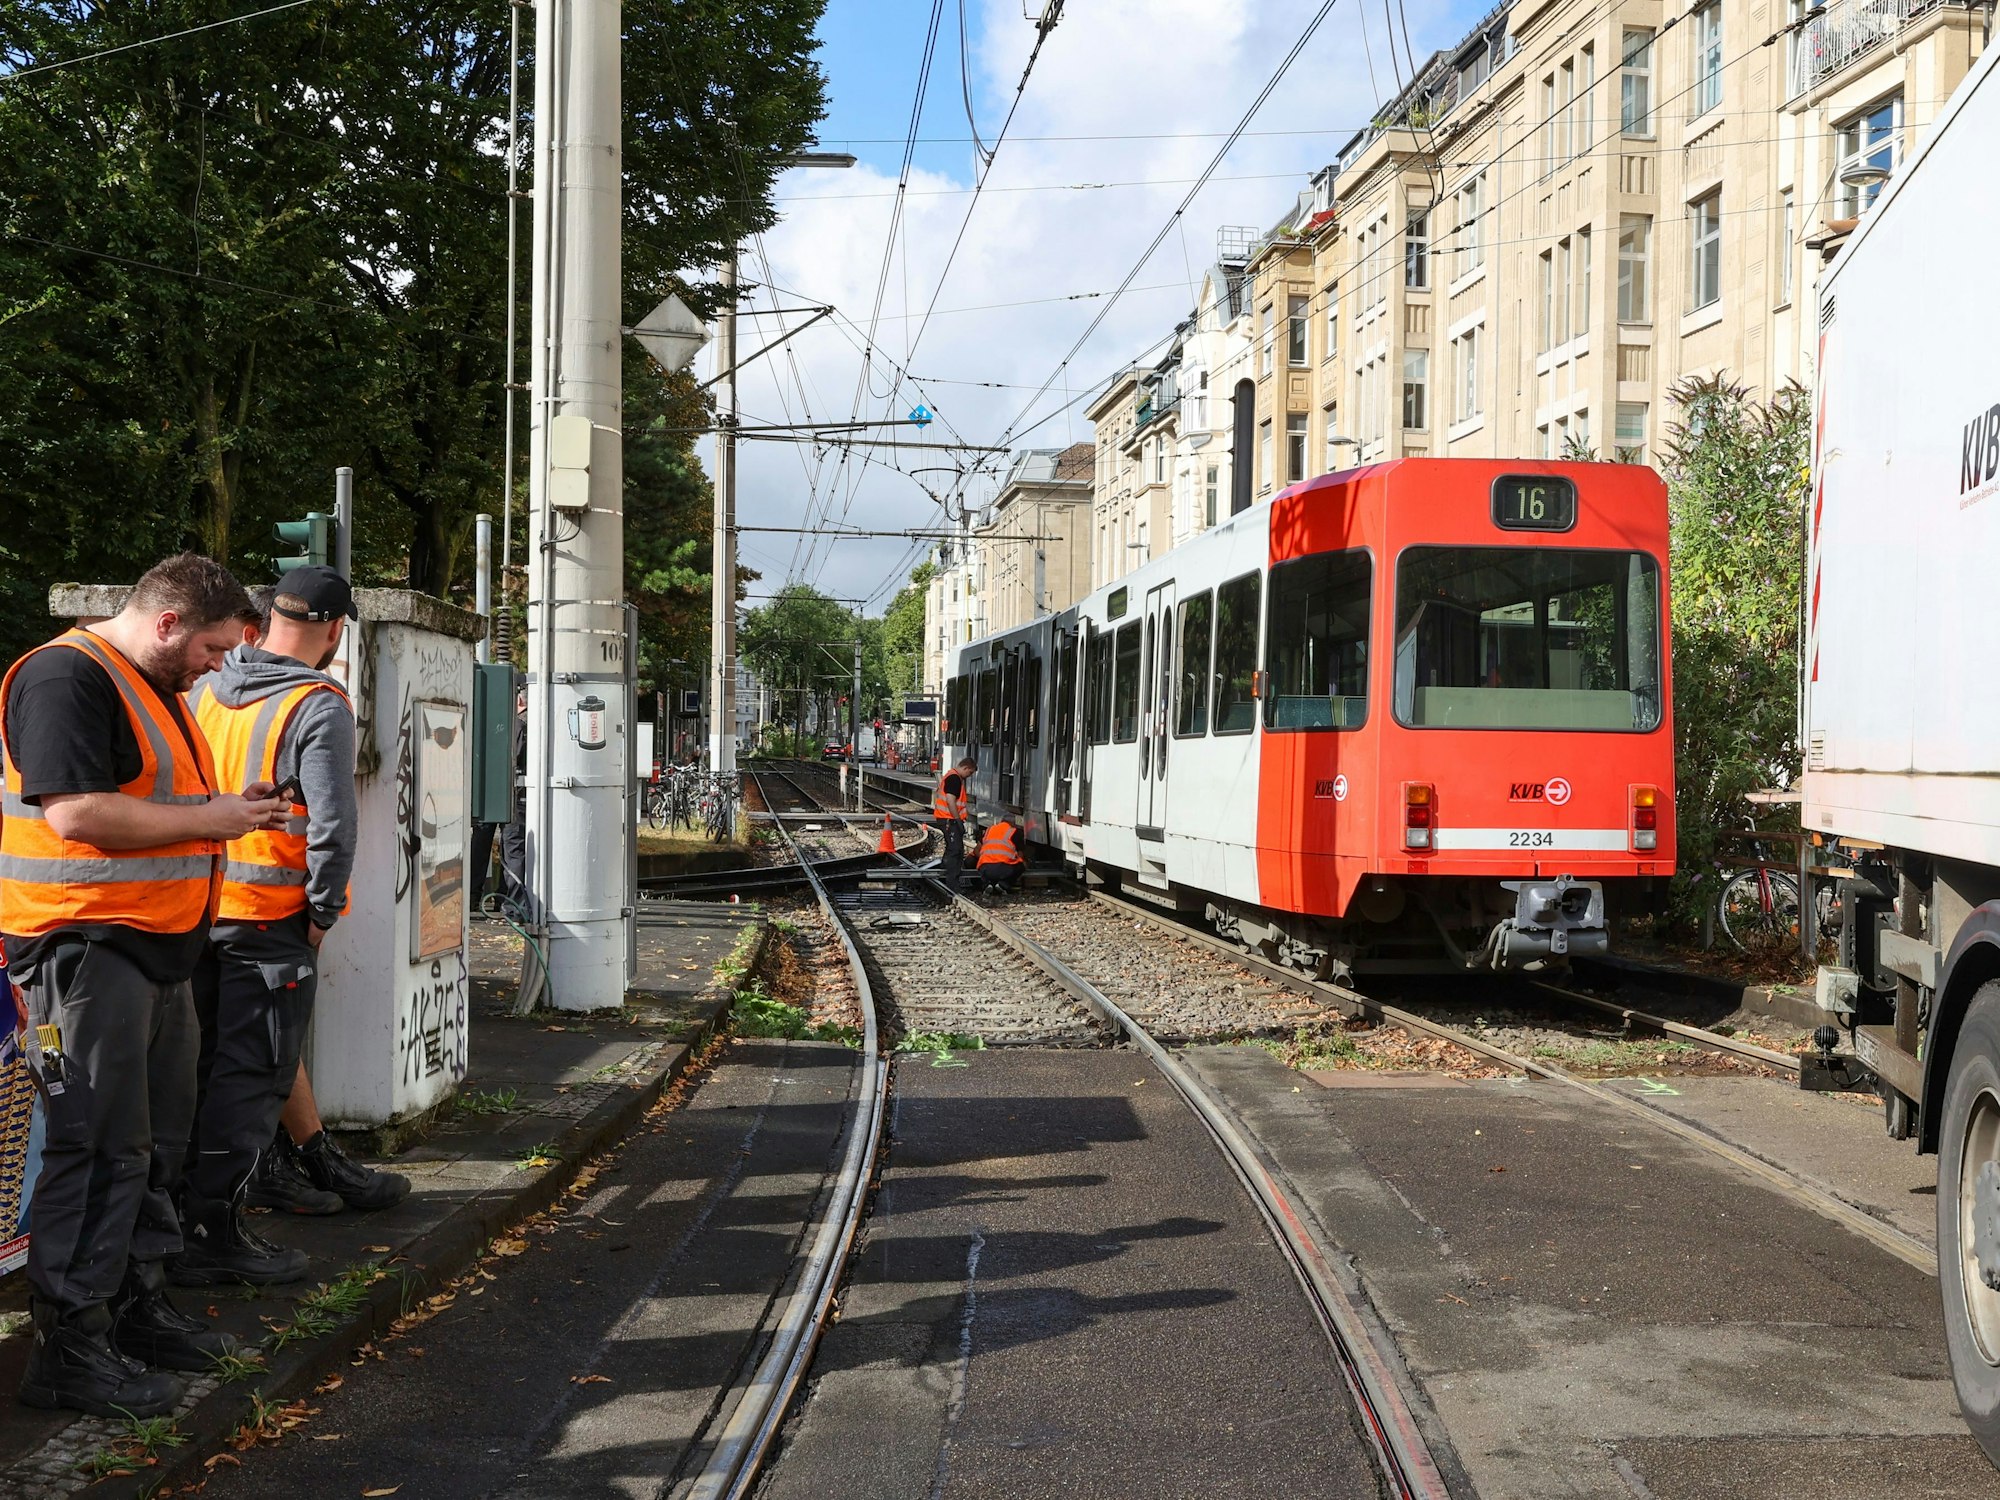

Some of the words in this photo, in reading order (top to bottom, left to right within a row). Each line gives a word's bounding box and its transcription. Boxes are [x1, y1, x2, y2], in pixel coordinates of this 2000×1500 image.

[1960, 403, 2000, 495] KVB
[1517, 486, 1546, 520] 16
[600, 641, 623, 662] 10
[1314, 780, 1334, 796] KVB
[1509, 783, 1545, 799] KVB
[1509, 831, 1554, 847] 2234
